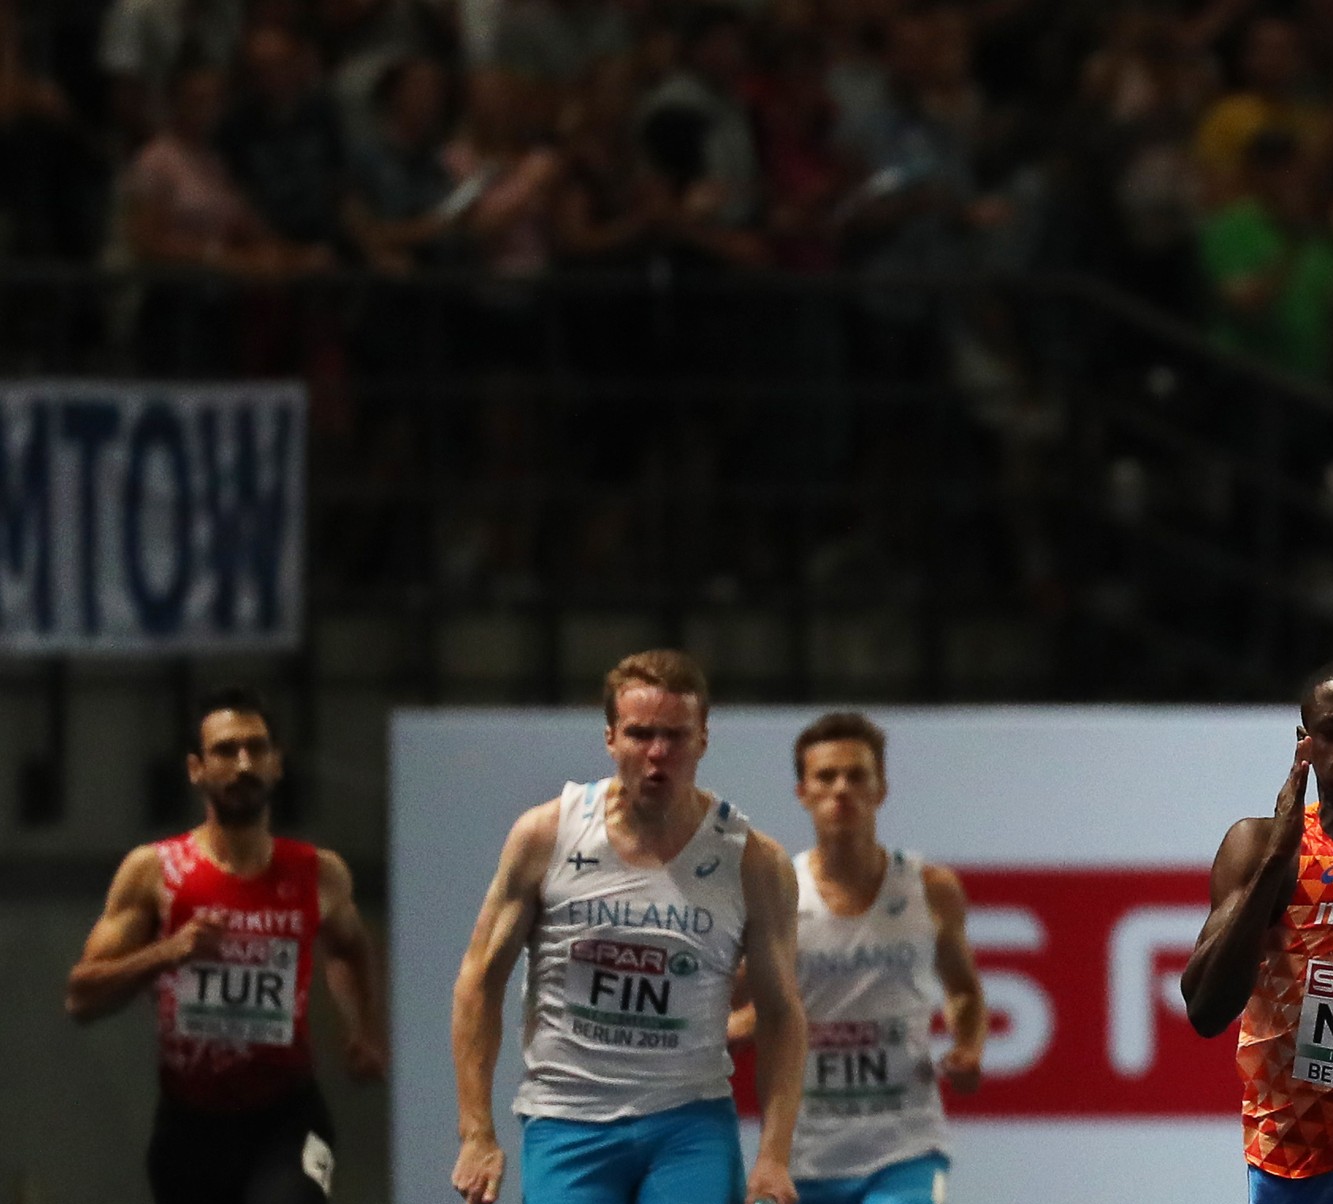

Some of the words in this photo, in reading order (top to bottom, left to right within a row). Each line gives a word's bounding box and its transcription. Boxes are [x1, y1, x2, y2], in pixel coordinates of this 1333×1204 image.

[569, 900, 713, 934] FINLAND
[572, 942, 663, 971] SPAR
[192, 968, 284, 1007] TUR
[590, 970, 670, 1015] FIN
[572, 1017, 633, 1046] BERLIN
[637, 1030, 679, 1048] 2018
[816, 1050, 887, 1083] FIN
